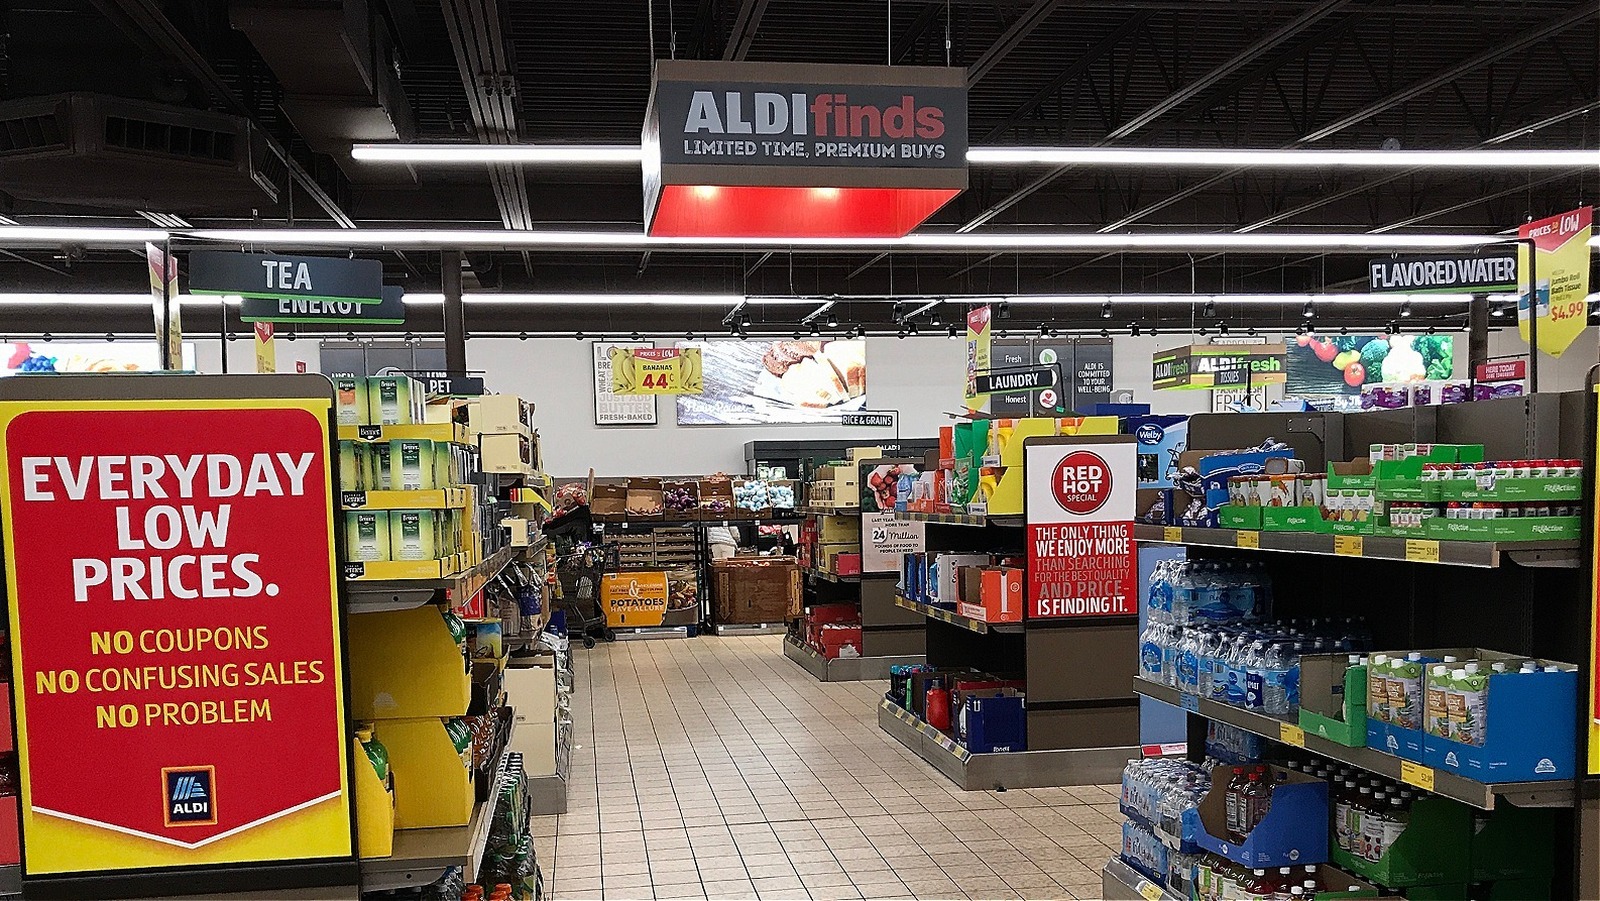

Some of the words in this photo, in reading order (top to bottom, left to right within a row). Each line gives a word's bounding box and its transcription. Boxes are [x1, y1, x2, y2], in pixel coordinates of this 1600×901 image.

[684, 140, 757, 156] LIMITED
[761, 141, 810, 159] TIME,
[814, 142, 896, 159] PREMIUM
[900, 143, 945, 160] BUYS
[1529, 225, 1551, 237] PRICES
[1560, 213, 1580, 235] LOW
[262, 261, 312, 290] TEA
[1372, 260, 1456, 288] FLAVORED
[1458, 257, 1515, 282] WATER
[1551, 301, 1584, 322] $4.99
[1005, 355, 1022, 363] Fresh
[1499, 364, 1516, 372] TODAY
[429, 380, 452, 393] PET
[989, 373, 1039, 390] LAUNDRY
[1005, 395, 1026, 403] Honest
[599, 403, 652, 413] BUTTER
[842, 415, 858, 425] RICE
[859, 416, 865, 425] &
[866, 416, 892, 426] GRAINS
[1139, 430, 1162, 440] Welby
[21, 452, 315, 502] EVERYDAY
[1063, 465, 1102, 480] RED
[1063, 481, 1102, 494] HOT
[1067, 494, 1097, 502] SPECIAL
[115, 504, 232, 551] LOW
[1036, 527, 1058, 540] THE
[1061, 526, 1090, 540] ONLY
[1092, 525, 1127, 539] THING
[873, 531, 885, 540] 24
[889, 531, 918, 539] Million
[1036, 540, 1056, 557] WE
[1058, 539, 1093, 558] ENJOY
[1096, 538, 1129, 555] MORE
[1035, 559, 1065, 571] THAN
[1068, 556, 1130, 570] SEARCHING
[72, 553, 280, 602] PRICES.
[1035, 572, 1052, 582] FOR
[1053, 571, 1071, 582] THE
[1072, 570, 1092, 581] BEST
[1094, 569, 1130, 580] QUALITY
[1039, 582, 1072, 599] AND
[611, 598, 664, 606] POTATOES
[1037, 600, 1050, 615] IS
[1053, 598, 1110, 615] FINDING
[1112, 596, 1128, 612] IT.
[90, 628, 134, 655] NO
[138, 626, 269, 654] COUPONS
[35, 669, 80, 695] NO
[84, 663, 239, 693] CONFUSING
[244, 660, 325, 686] SALES
[96, 702, 139, 729] NO
[145, 699, 272, 727] PROBLEM
[172, 801, 209, 815] ALDI
